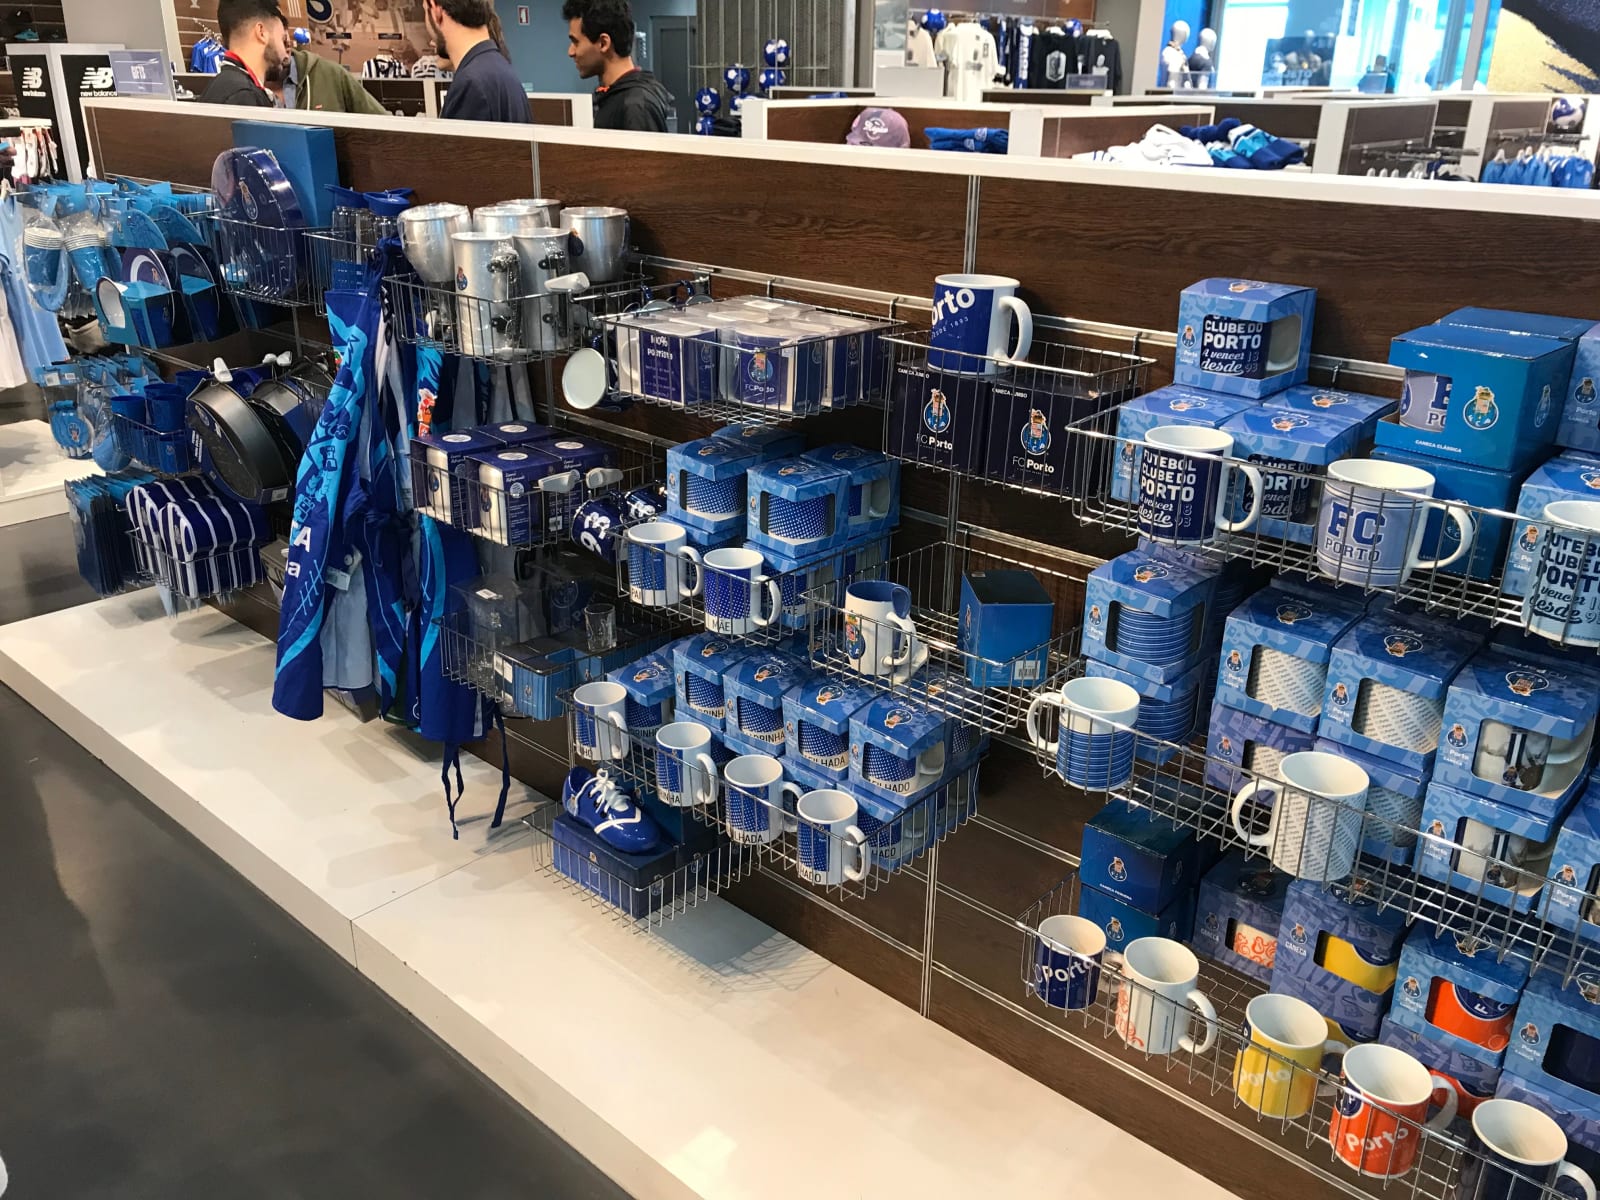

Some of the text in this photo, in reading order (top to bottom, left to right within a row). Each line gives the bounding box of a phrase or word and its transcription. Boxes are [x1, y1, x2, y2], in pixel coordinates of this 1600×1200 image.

[1204, 320, 1263, 334] CLUBE DO
[1203, 332, 1262, 350] PORTO
[1200, 358, 1244, 374] desde
[1143, 449, 1197, 472] FUTEBOL
[1142, 462, 1174, 483] CLUBE
[1176, 472, 1197, 485] DO
[1263, 474, 1310, 490] ORTO
[1141, 475, 1195, 502] PORTO
[1328, 502, 1386, 546] FC
[1325, 538, 1381, 563] PORTO
[1536, 560, 1600, 594] PORT
[712, 618, 731, 632] MÃE
[1285, 941, 1307, 957] CANECA
[1345, 1128, 1409, 1152] Porto
